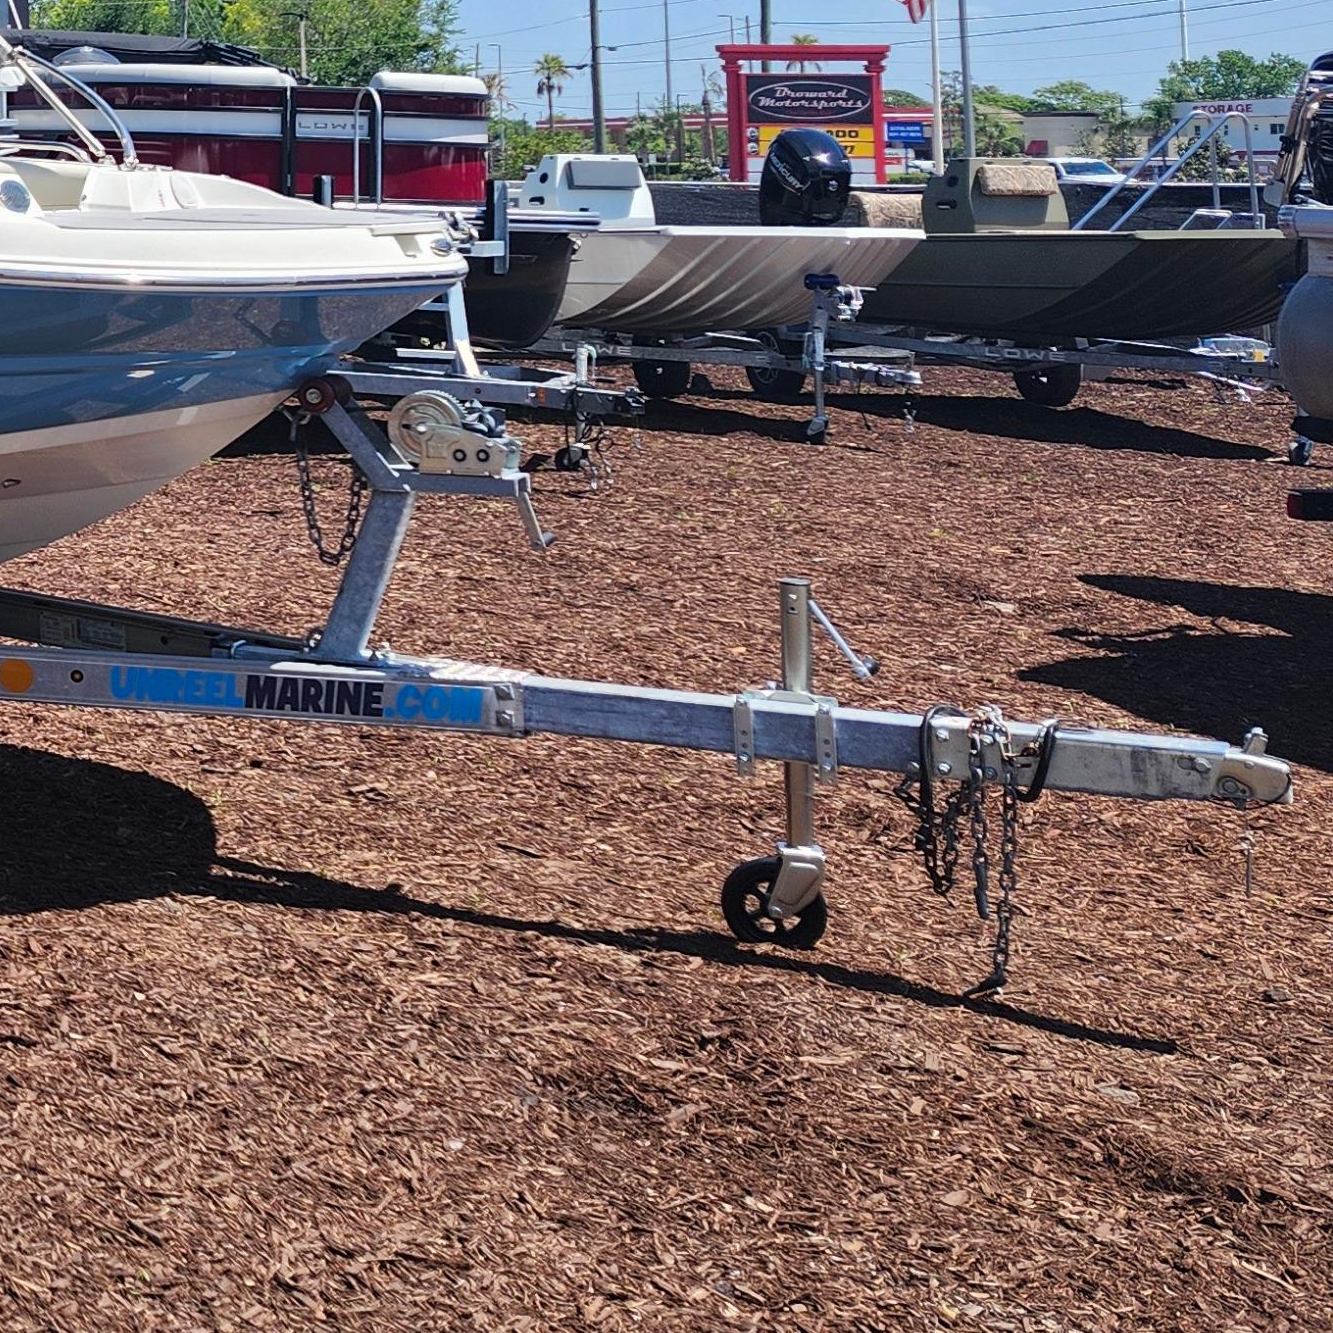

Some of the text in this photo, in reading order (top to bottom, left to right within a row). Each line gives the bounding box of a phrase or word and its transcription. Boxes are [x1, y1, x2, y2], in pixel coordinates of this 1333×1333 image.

[774, 87, 849, 98] Broward
[757, 97, 863, 109] Motorsports
[298, 122, 365, 131] LOWE
[562, 342, 632, 356] LWE
[985, 347, 1066, 361] LOWE
[108, 667, 483, 724] UNREELMARINE.COM
